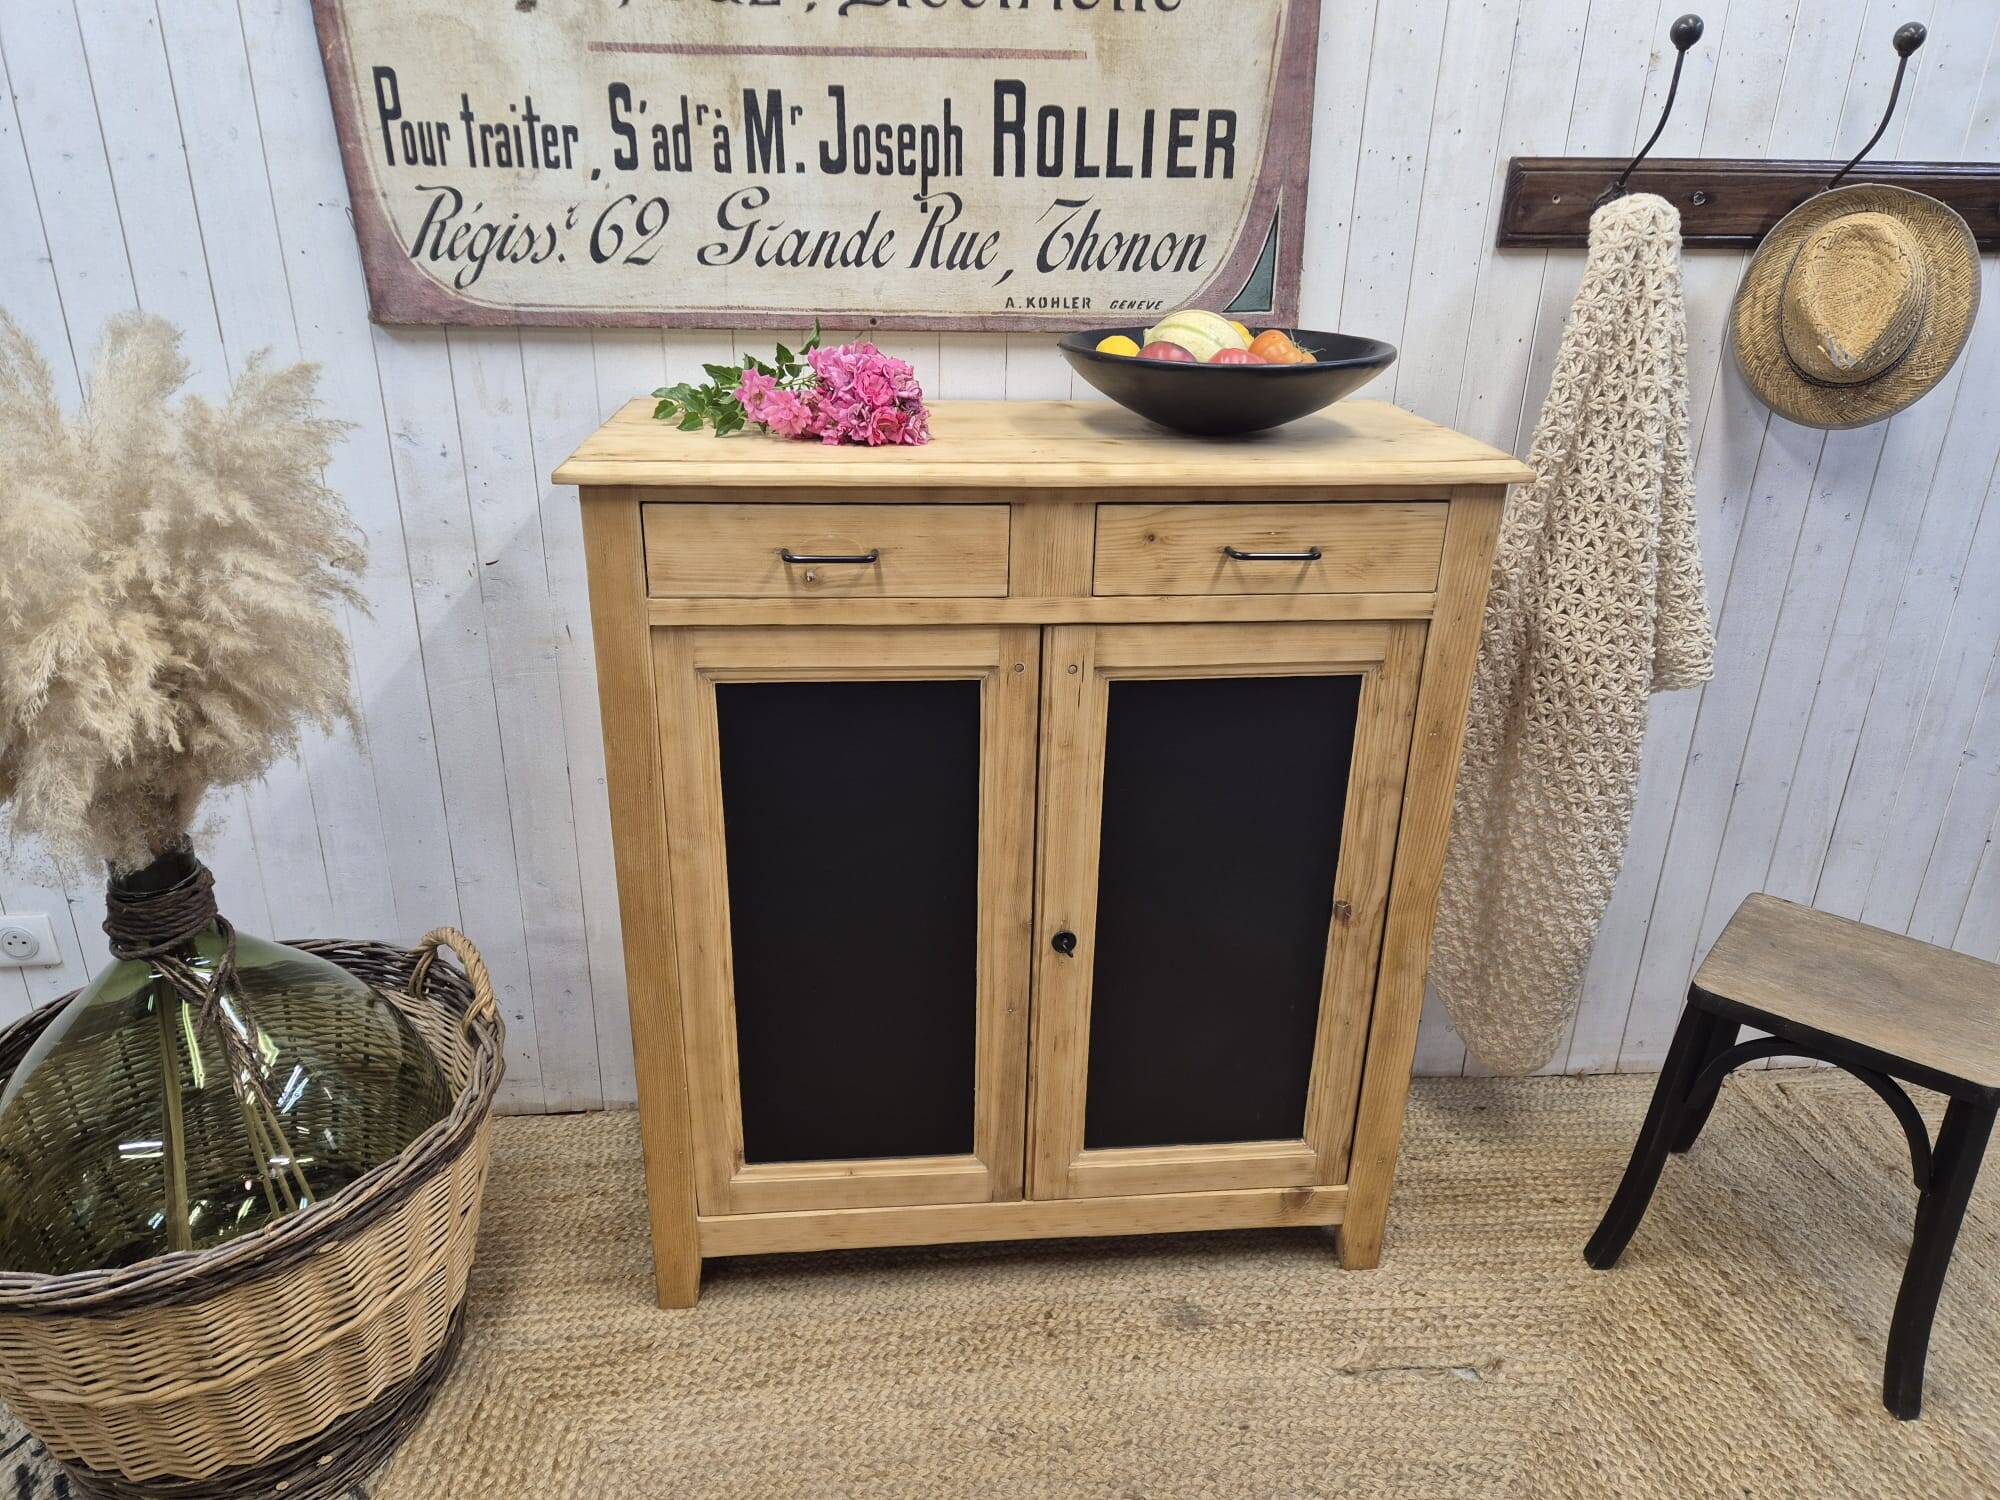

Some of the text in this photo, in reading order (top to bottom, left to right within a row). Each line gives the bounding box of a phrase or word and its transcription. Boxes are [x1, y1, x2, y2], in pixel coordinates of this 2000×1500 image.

[372, 66, 451, 167] Pour
[818, 84, 964, 213] Joseph
[993, 78, 1238, 180] ROLLIER
[589, 194, 670, 266] 62
[905, 192, 1014, 287] Rue,
[1034, 194, 1208, 274] Thonon
[1109, 300, 1164, 311] GENEVE
